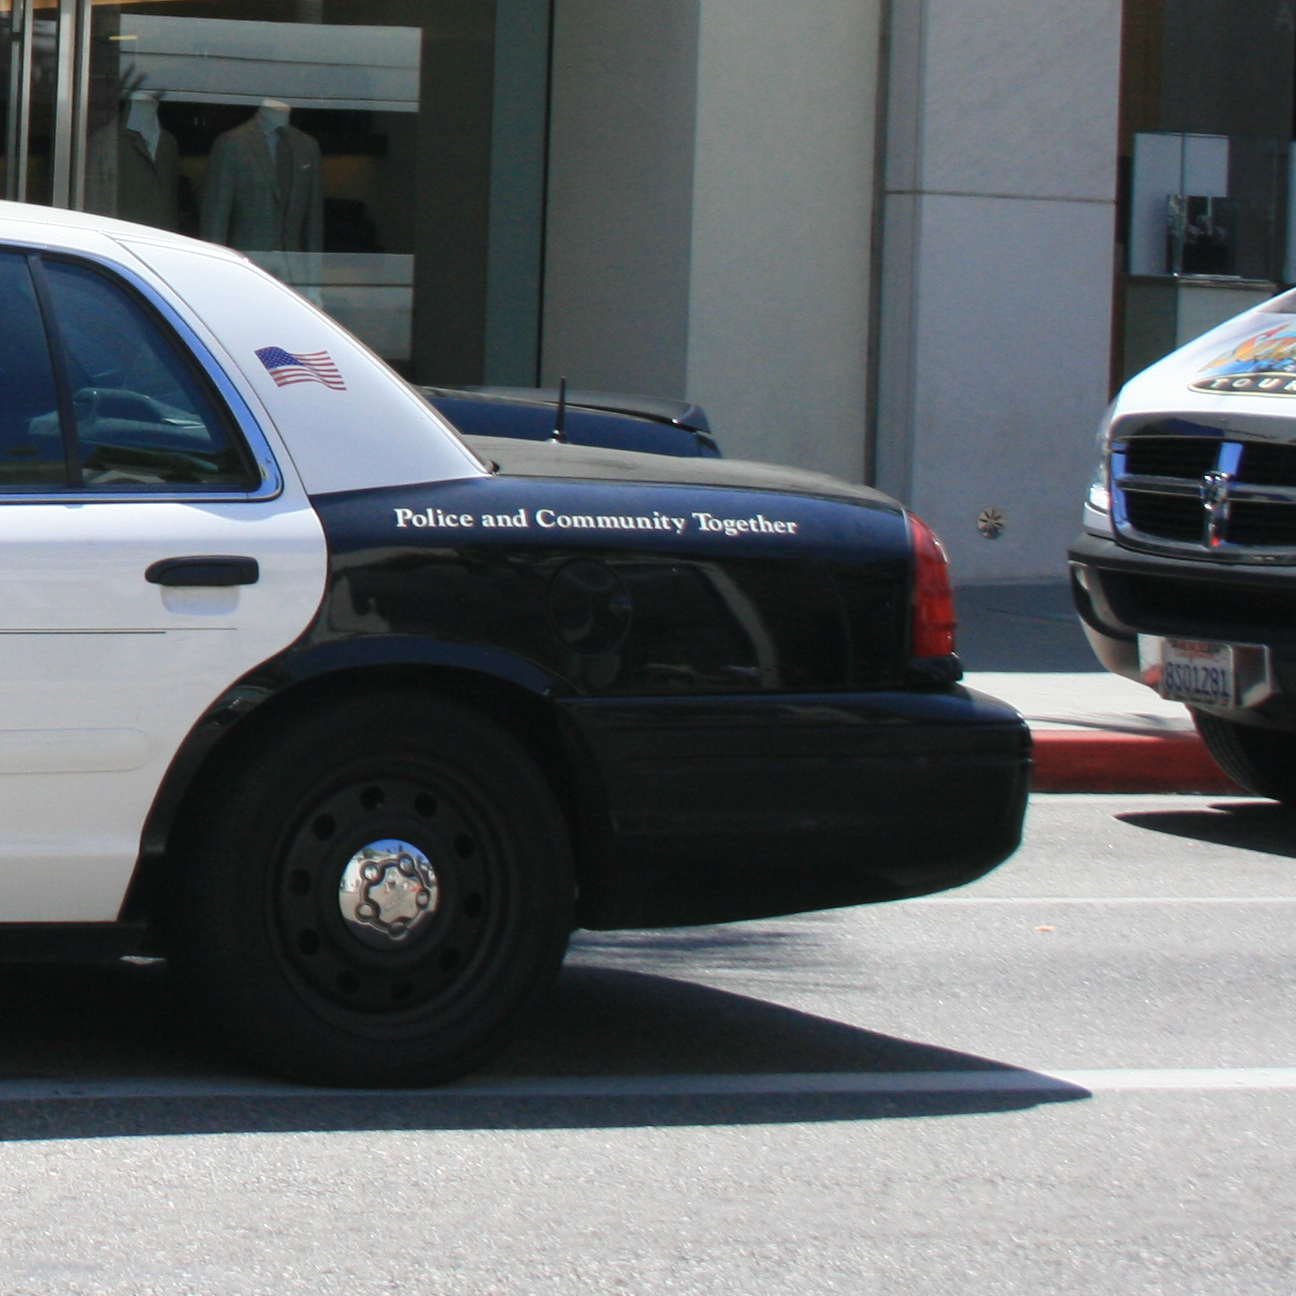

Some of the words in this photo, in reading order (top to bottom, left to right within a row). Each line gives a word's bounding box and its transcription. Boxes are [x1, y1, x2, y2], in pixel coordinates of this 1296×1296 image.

[393, 507, 474, 529] Police
[481, 508, 529, 529] and
[535, 508, 686, 535] Community
[692, 511, 798, 537] Together
